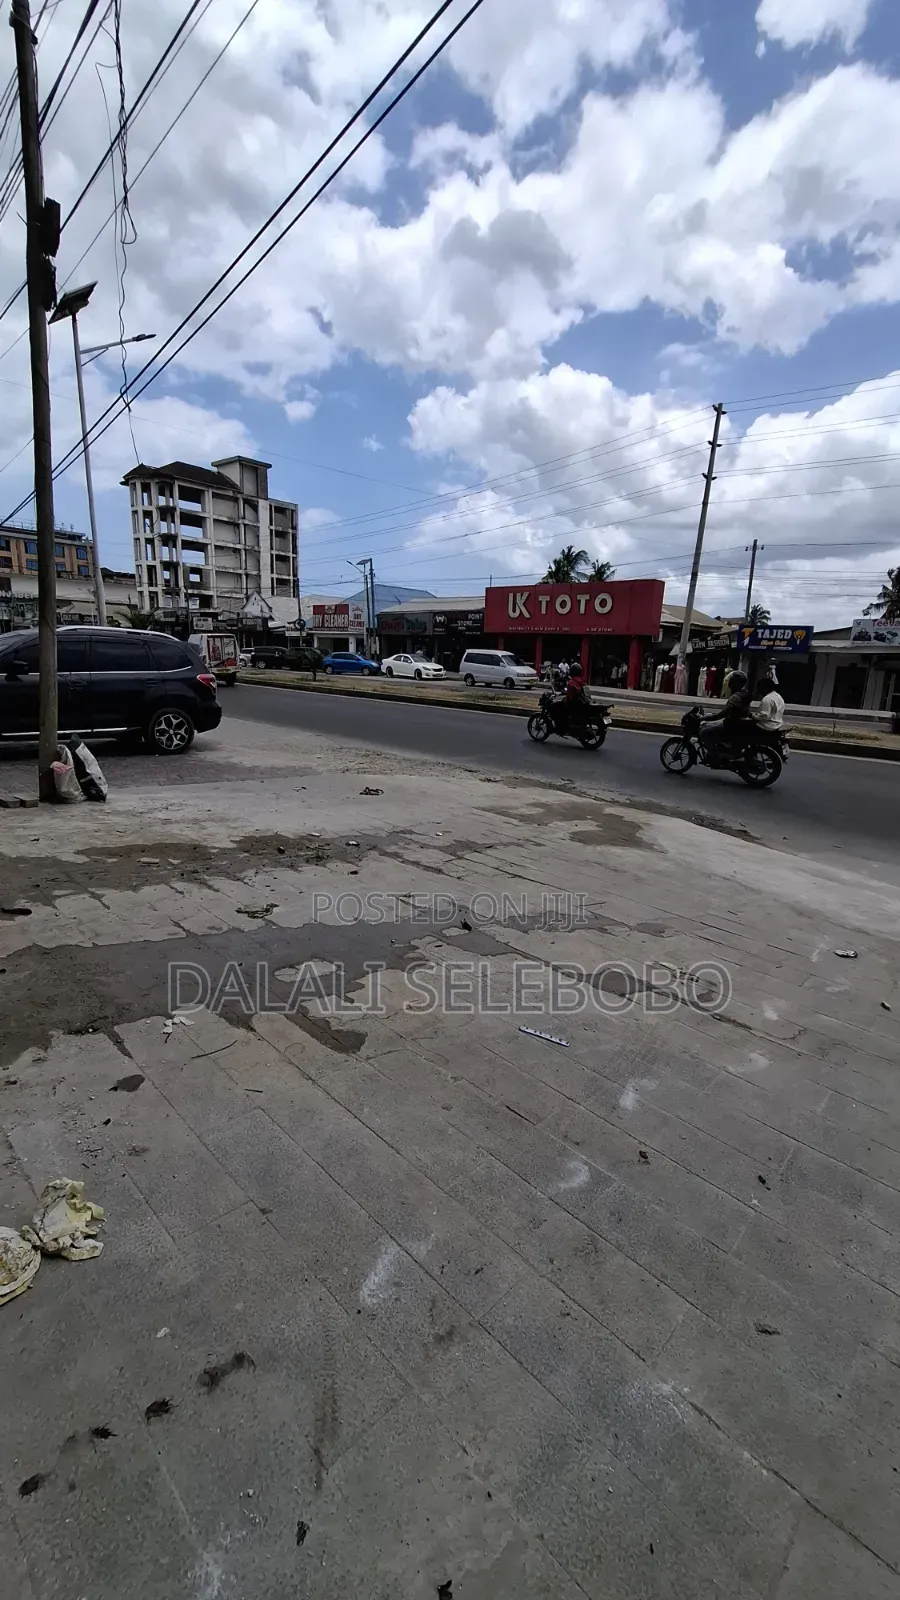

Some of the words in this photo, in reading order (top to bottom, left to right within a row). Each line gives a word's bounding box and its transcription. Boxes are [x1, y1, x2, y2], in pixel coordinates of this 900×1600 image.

[508, 591, 531, 619] UK
[538, 592, 613, 615] TOTO
[324, 614, 348, 628] CLEANER
[756, 628, 792, 640] TAJED
[707, 638, 730, 648] FASHION
